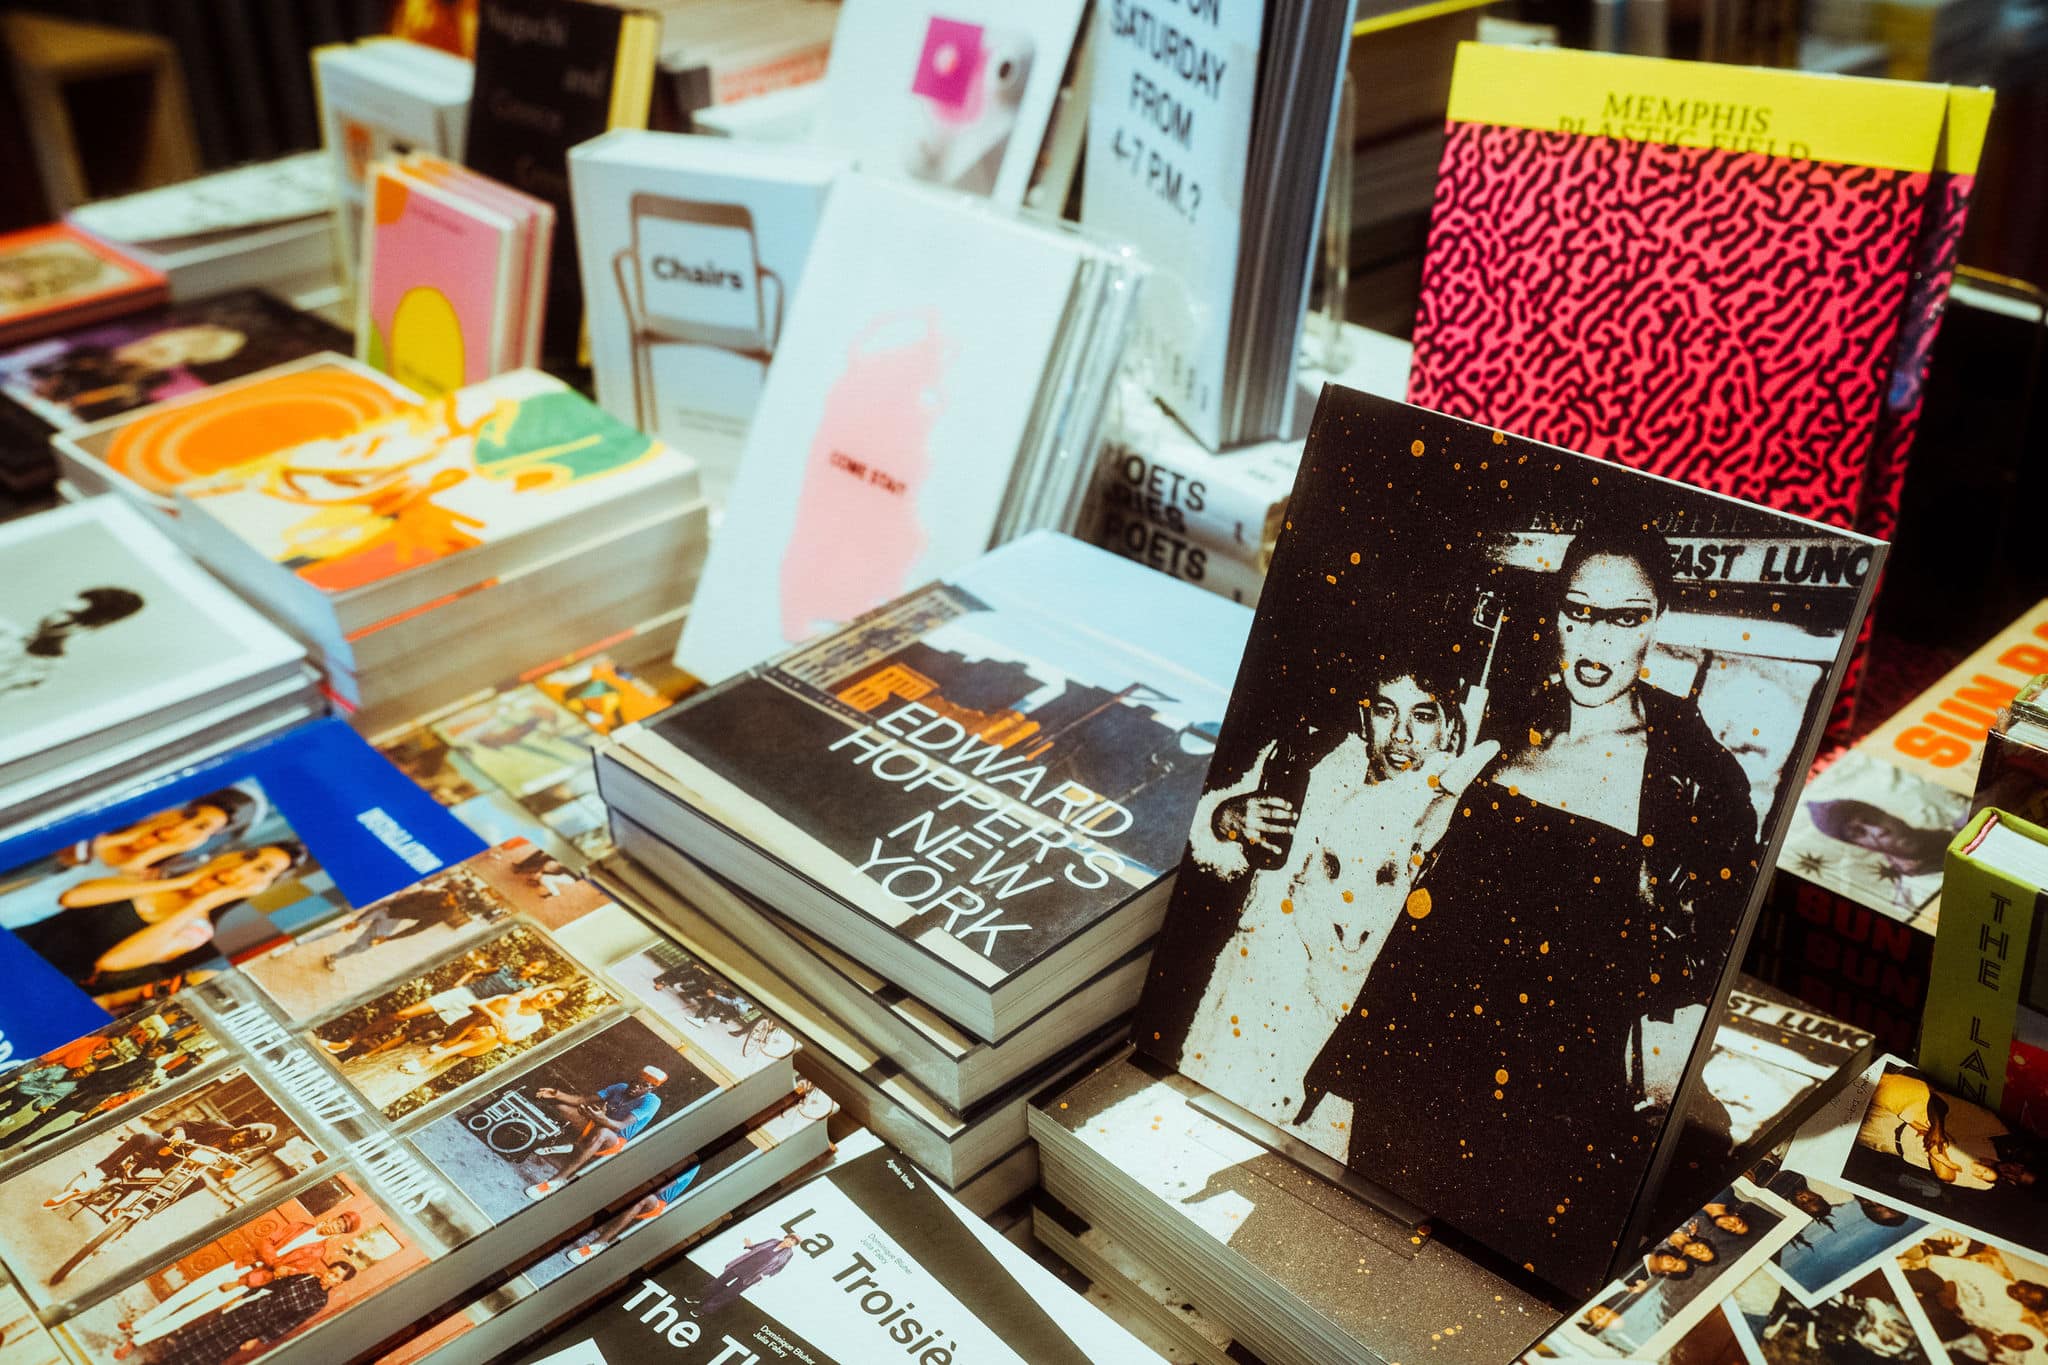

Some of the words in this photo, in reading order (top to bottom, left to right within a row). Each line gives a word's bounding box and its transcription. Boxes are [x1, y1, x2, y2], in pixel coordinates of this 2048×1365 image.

[1111, 0, 1227, 100] SATURDAY
[1130, 71, 1193, 150] FROM
[1601, 91, 1774, 135] MEMPHIS
[651, 255, 744, 290] Chairs
[829, 451, 867, 480] COME
[1893, 674, 2021, 768] SUN
[827, 725, 1127, 890] HOPPER'S
[876, 700, 1135, 838] EDWARD
[852, 836, 1034, 958] YORK
[887, 810, 1056, 901] NEW
[1977, 890, 2012, 992] THE
[215, 1000, 292, 1058] JAMEL
[265, 1048, 366, 1131] SHABAZZ
[349, 1130, 448, 1216] ALBUMS
[780, 1208, 834, 1260] La
[622, 1278, 701, 1348] The
[706, 1334, 761, 1365] T
[752, 1331, 770, 1346] Julia
[767, 1340, 788, 1359] Fabry
[760, 1324, 795, 1352] Dominique
